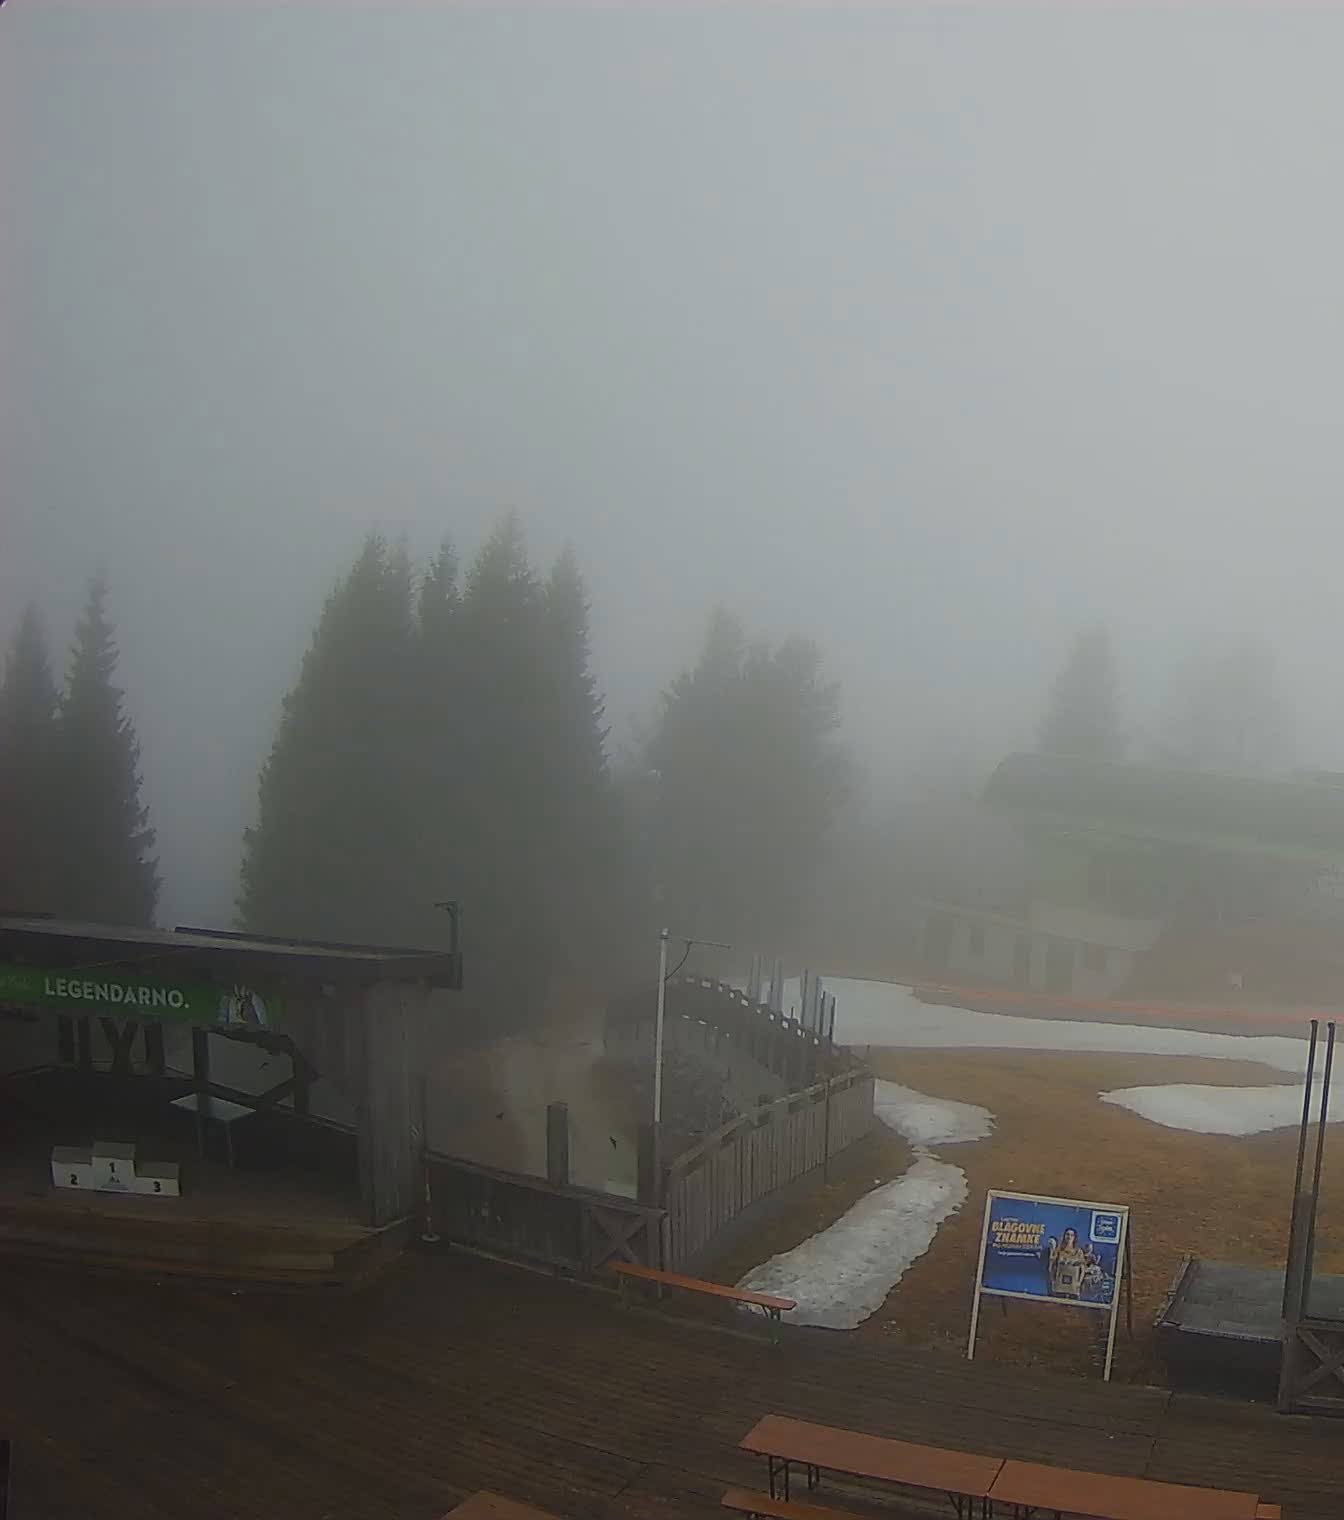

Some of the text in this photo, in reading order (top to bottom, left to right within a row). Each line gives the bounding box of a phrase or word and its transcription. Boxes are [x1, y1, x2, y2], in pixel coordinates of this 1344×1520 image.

[44, 977, 190, 1009] LEGENDARNO.
[108, 1162, 116, 1173] 1
[70, 1174, 78, 1185] 2
[153, 1181, 161, 1192] 3
[992, 1221, 1045, 1234] BLAGOVNE
[995, 1232, 1041, 1244] ZNAMKE
